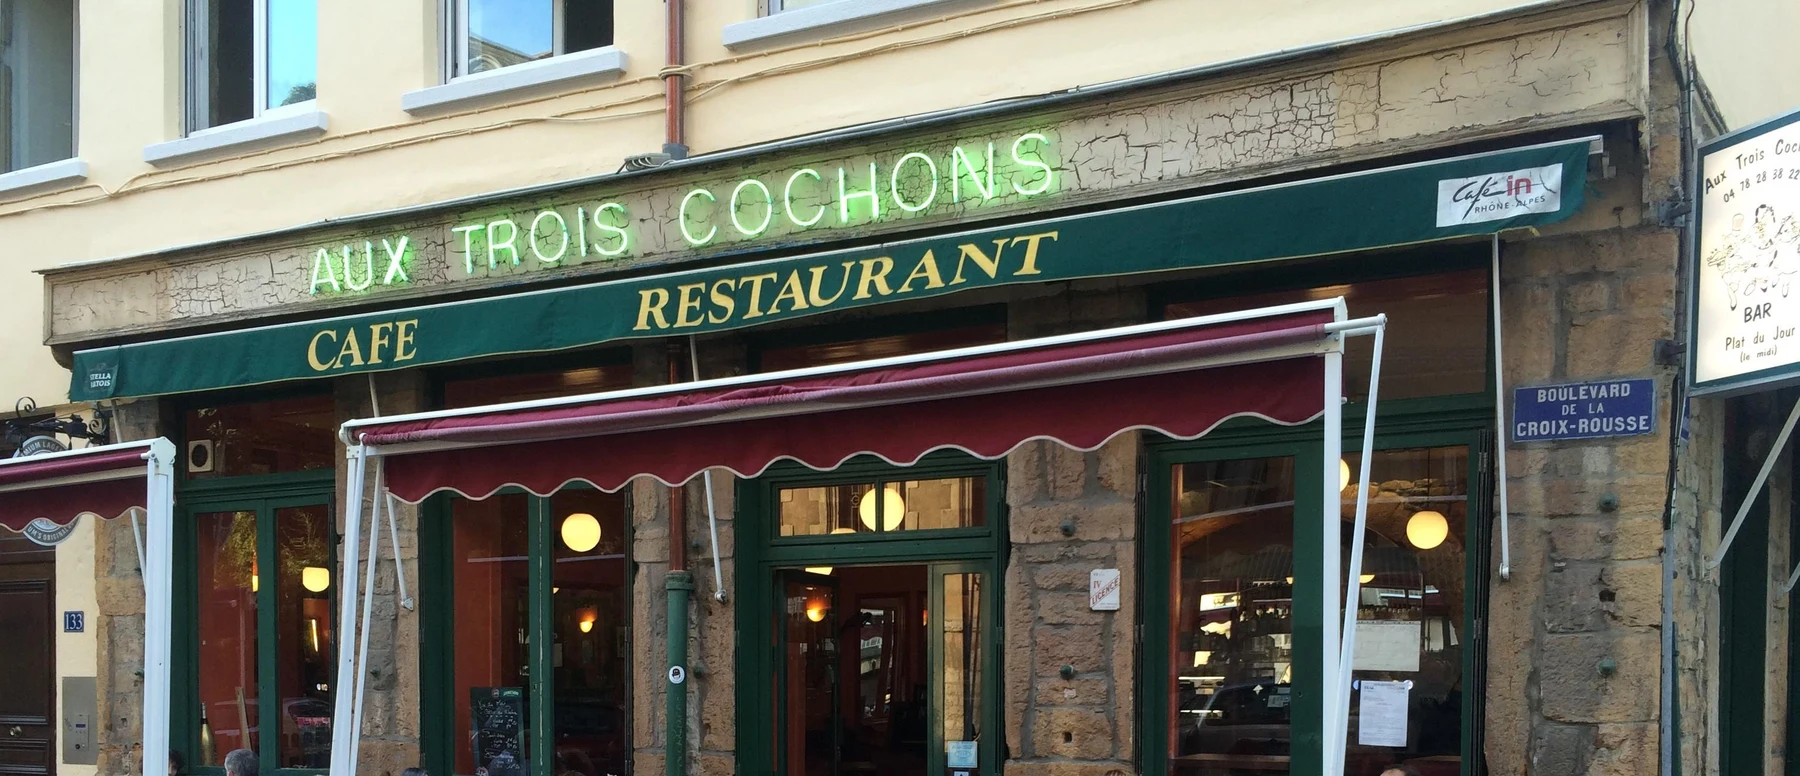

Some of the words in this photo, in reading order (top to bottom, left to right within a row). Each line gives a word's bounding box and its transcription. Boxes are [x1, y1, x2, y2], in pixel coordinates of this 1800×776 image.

[1705, 170, 1727, 195] Aux
[1735, 148, 1765, 170] Trois
[1775, 138, 1800, 155] Coc
[1452, 176, 1498, 220] Café
[1507, 175, 1532, 196] in
[1723, 188, 1735, 203] 04
[1740, 178, 1751, 191] 78
[1756, 170, 1767, 184] 28
[1773, 167, 1784, 180] 38
[1788, 168, 1800, 181] 22
[309, 235, 411, 295] AUX
[451, 202, 629, 274] TROIS
[679, 133, 1053, 245] COCHONS
[307, 319, 418, 372] CAFE
[632, 231, 1059, 331] RESTAURANT
[1744, 302, 1772, 323] BAR
[1725, 336, 1745, 351] Plat
[1753, 331, 1765, 345] du
[1773, 325, 1796, 341] Jour
[1740, 351, 1750, 363] (le
[1757, 344, 1778, 358] midi)
[1537, 383, 1631, 403] BOULEVARD
[1562, 404, 1577, 416] DE
[1588, 403, 1605, 414] LA
[1516, 415, 1650, 437] CROIX-ROUSSE
[1091, 577, 1119, 605] LICENCE
[65, 613, 83, 630] 133
